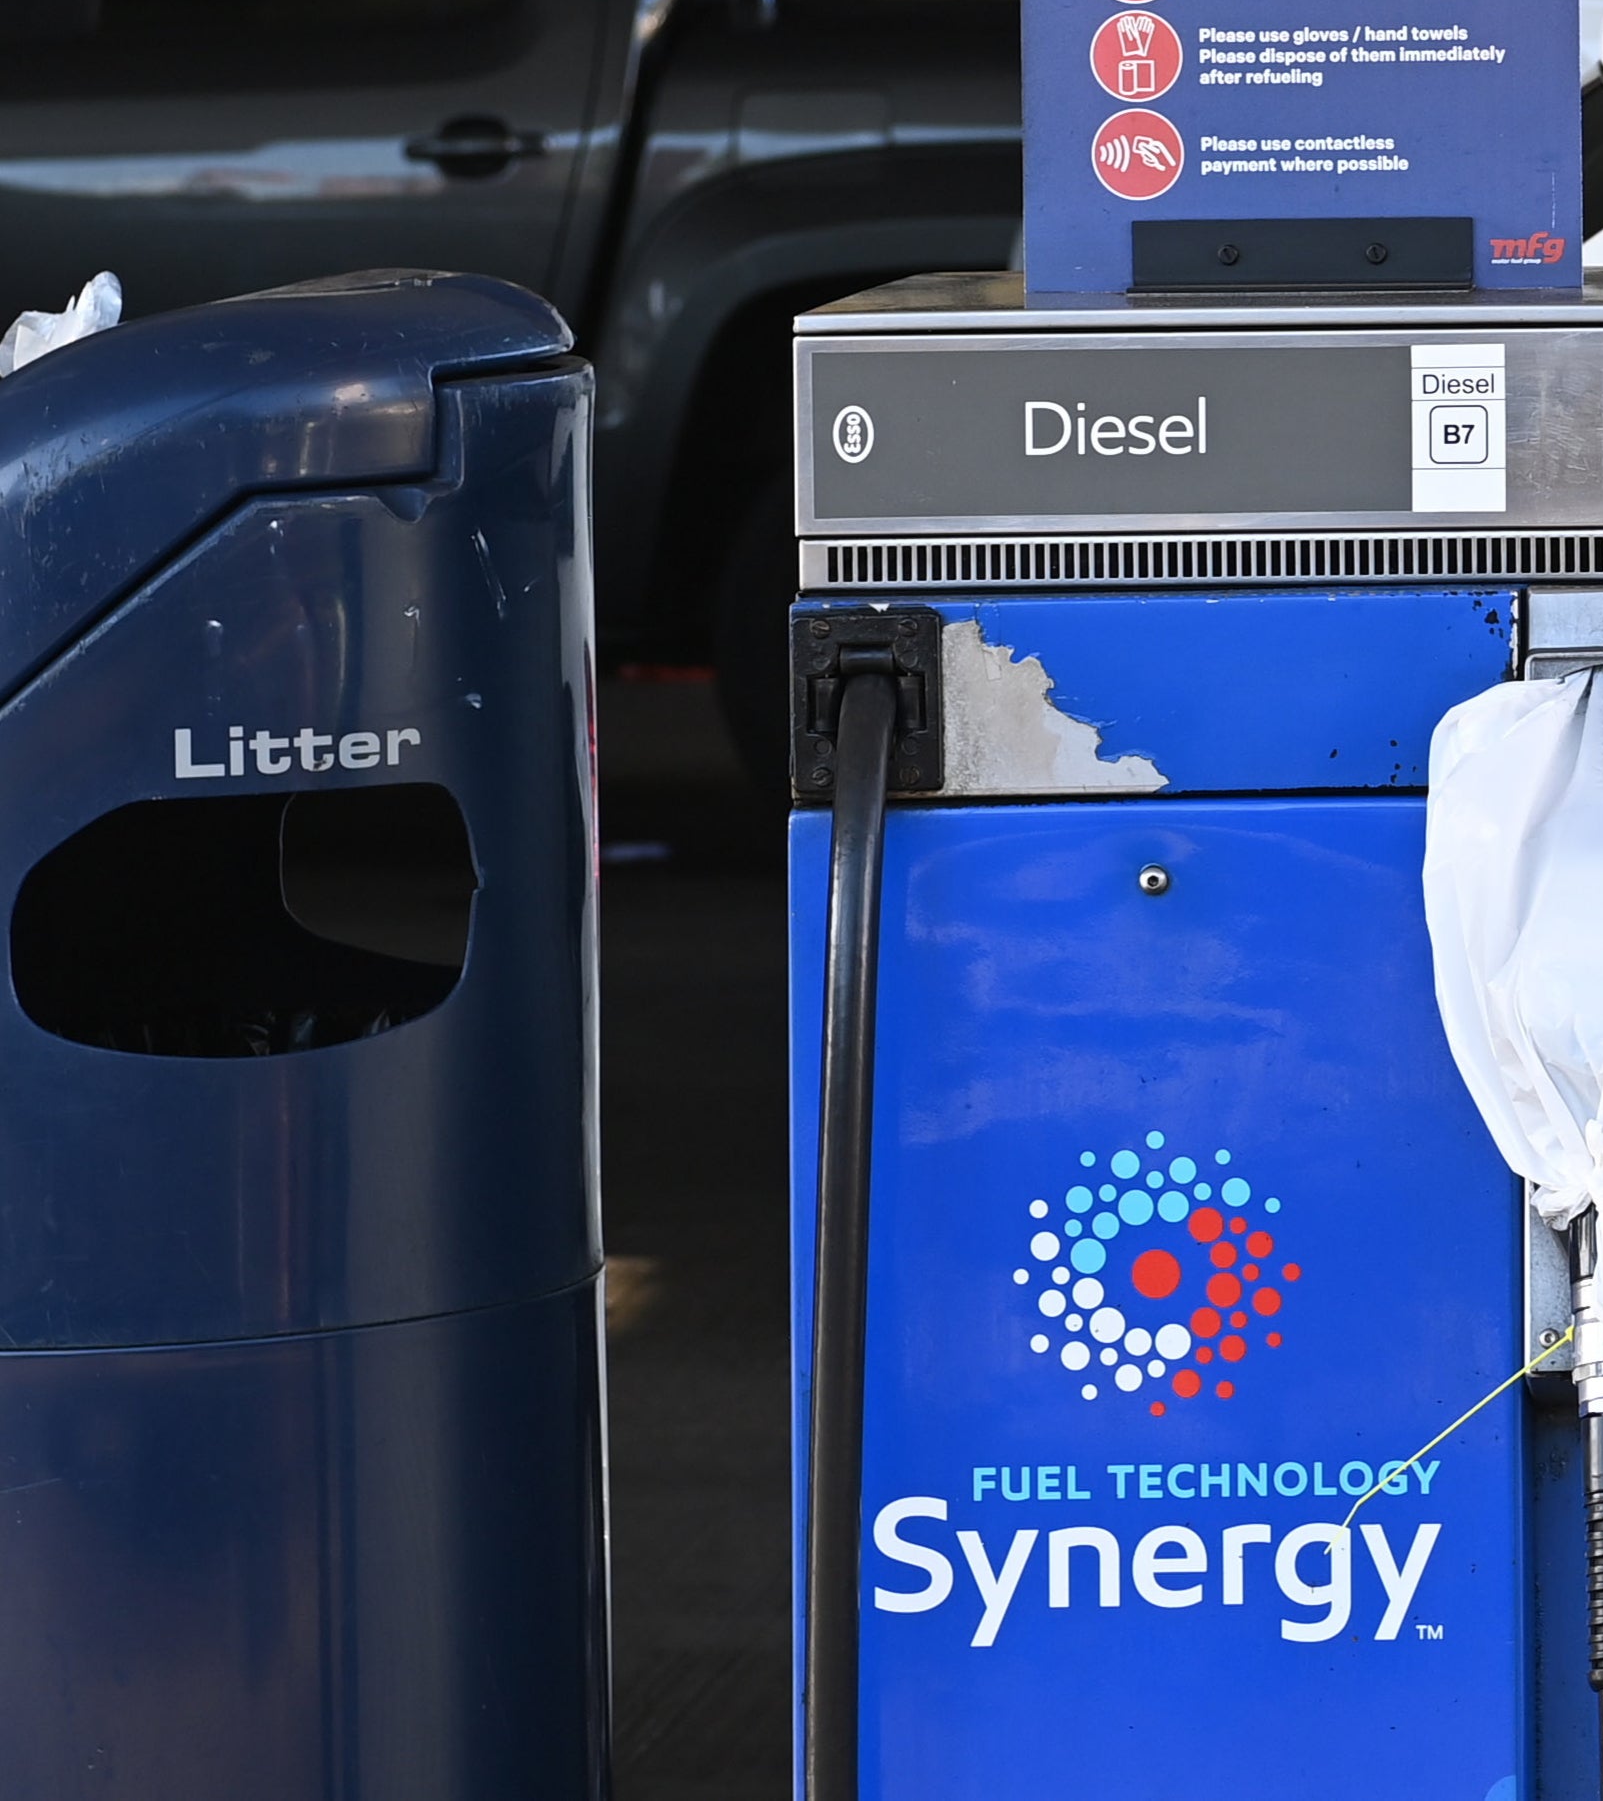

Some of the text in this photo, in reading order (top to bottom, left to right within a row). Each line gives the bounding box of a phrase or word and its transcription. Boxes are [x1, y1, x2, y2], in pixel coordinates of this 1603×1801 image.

[1489, 231, 1566, 264] mfg
[1421, 373, 1496, 396] Diesel
[1024, 396, 1207, 456] Diesel
[1443, 424, 1476, 446] B7
[174, 725, 422, 780] Litter
[972, 1459, 1442, 1502] FUEL TECHNOLOGY
[872, 1495, 1442, 1647] Synergy
